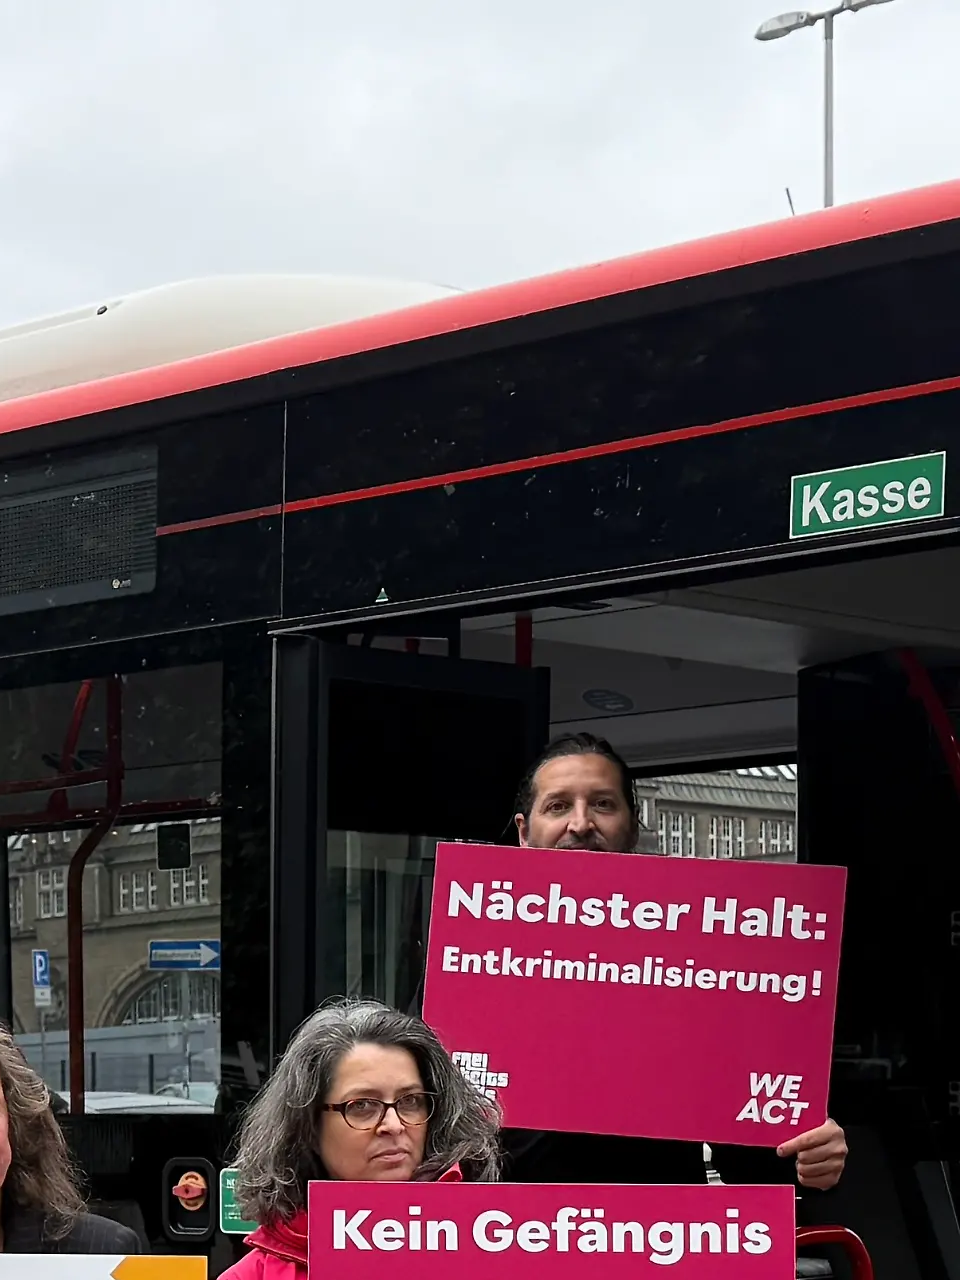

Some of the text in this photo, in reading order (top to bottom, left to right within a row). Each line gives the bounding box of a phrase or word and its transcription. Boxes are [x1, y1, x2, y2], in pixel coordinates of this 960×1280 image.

[802, 477, 931, 526] Kasse
[447, 880, 827, 940] Nächster Halt:
[36, 955, 45, 982] P
[442, 945, 822, 1002] Entkriminalisierung!
[749, 1072, 803, 1100] WE
[333, 1205, 772, 1265] Kein Gefängnis
